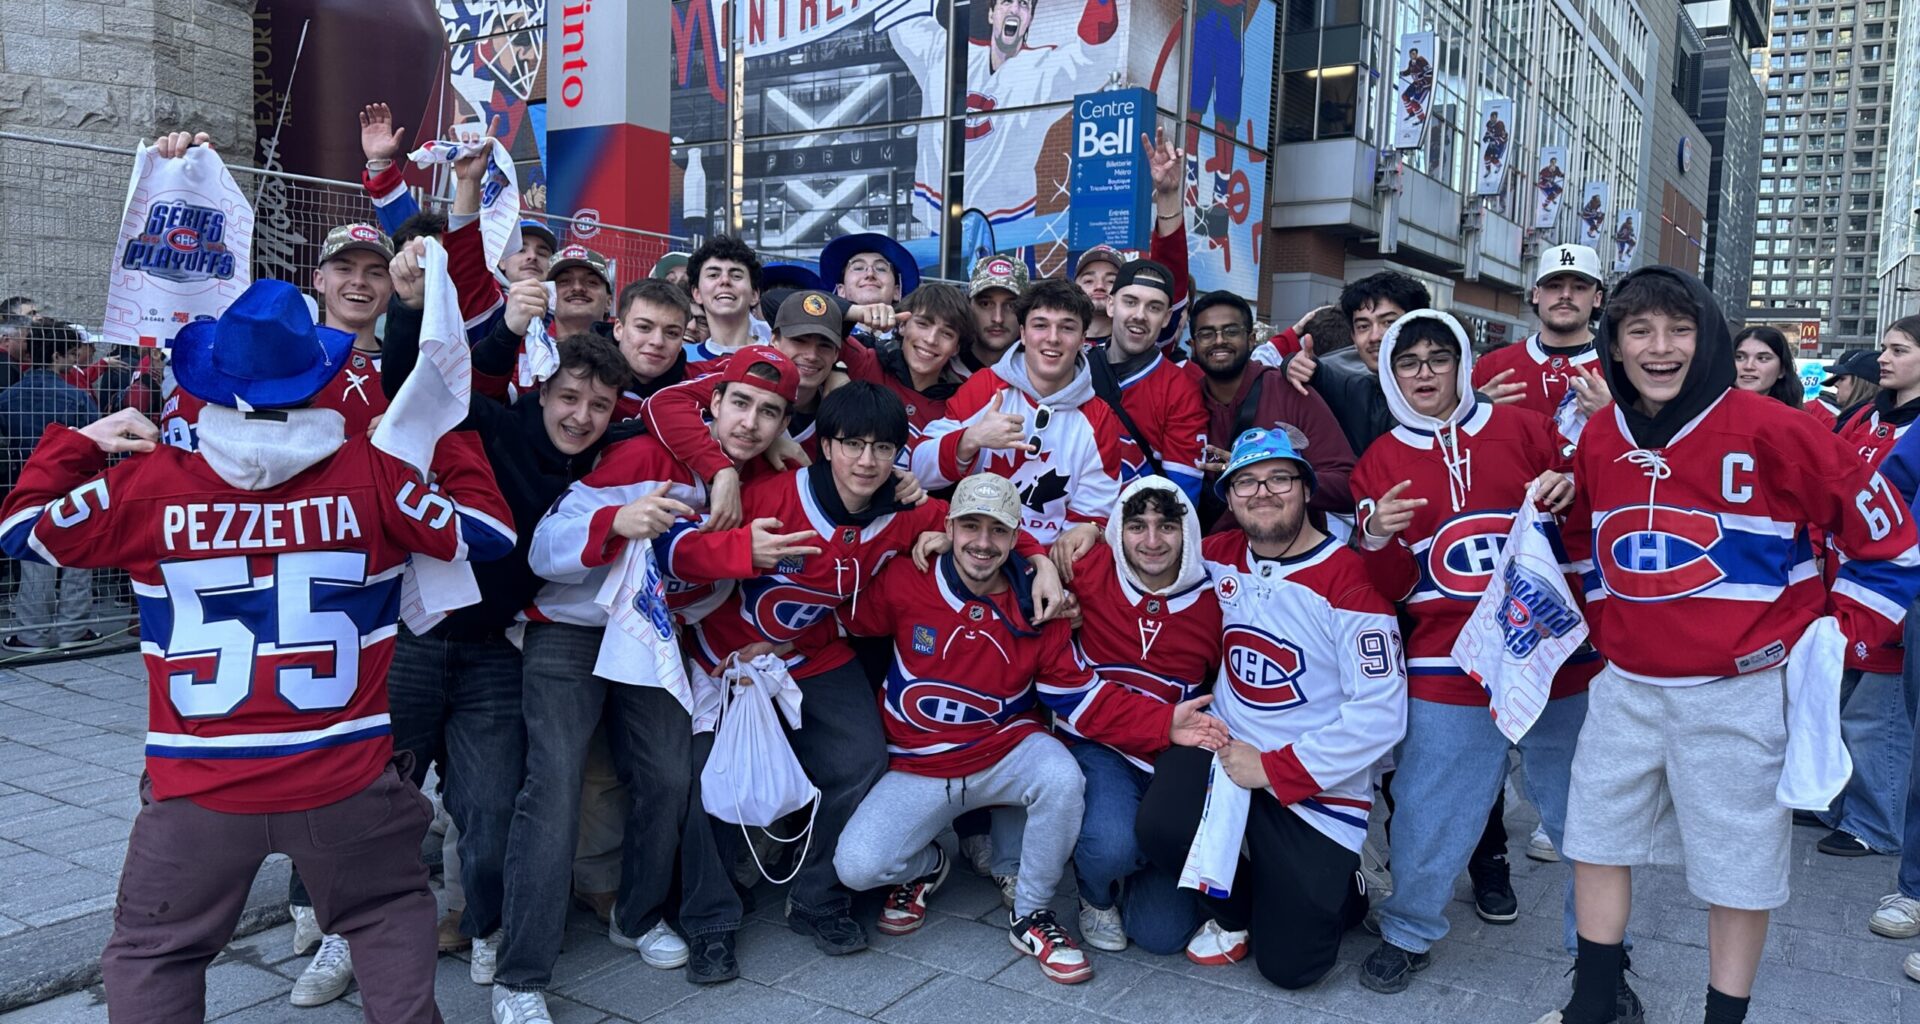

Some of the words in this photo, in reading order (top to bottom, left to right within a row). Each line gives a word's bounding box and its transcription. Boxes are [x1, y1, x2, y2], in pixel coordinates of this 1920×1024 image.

[562, 0, 591, 108] into
[1080, 100, 1135, 119] Centre
[1078, 117, 1134, 158] Bell
[767, 145, 895, 174] FORUM
[149, 203, 224, 243] SÉRIES
[126, 243, 233, 276] PLAYOFFS
[1721, 452, 1756, 504] C
[163, 495, 362, 551] PEZZETTA
[395, 480, 455, 530] 5
[1855, 470, 1904, 541] 67
[778, 565, 801, 574] RBC
[160, 551, 368, 718] 55
[915, 643, 932, 654] RBC
